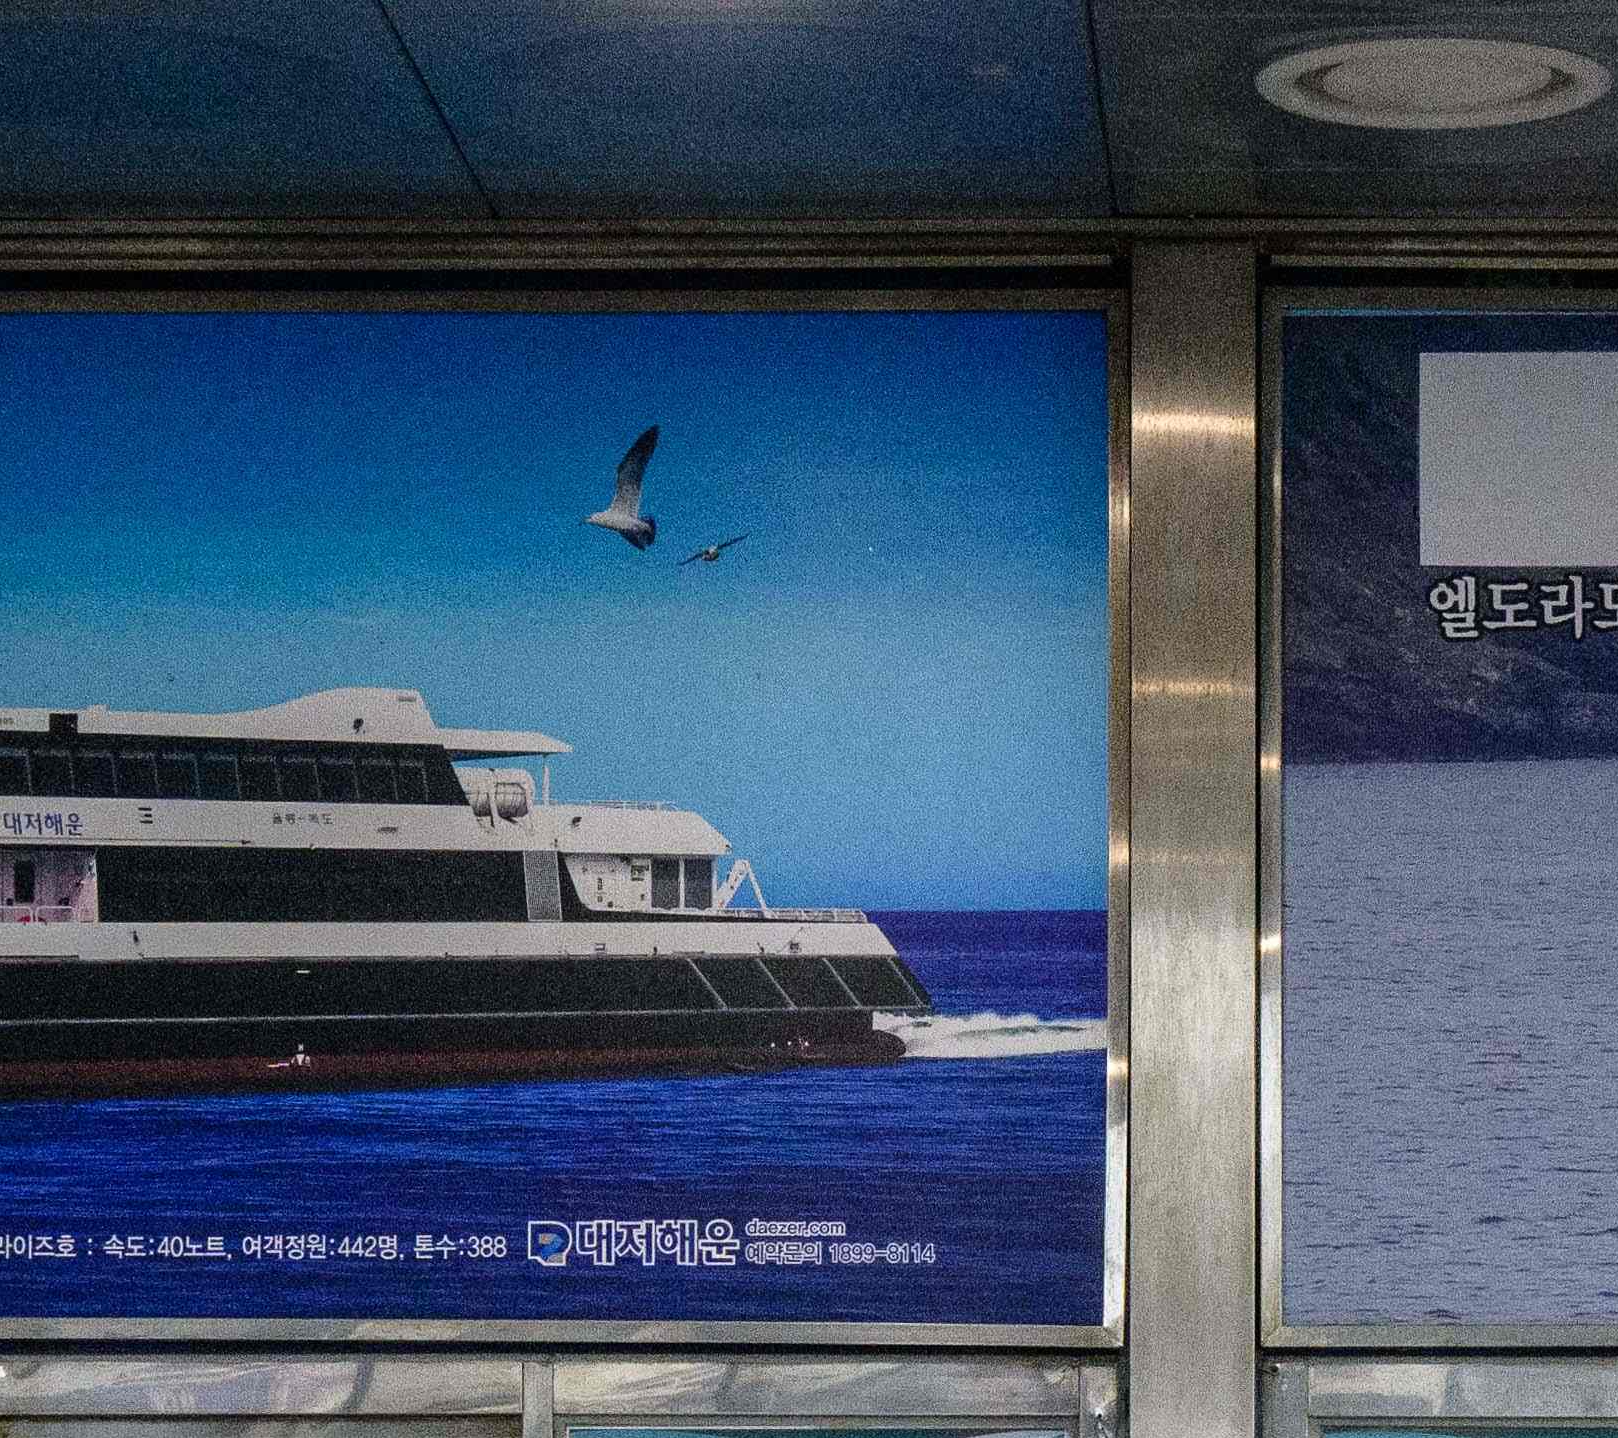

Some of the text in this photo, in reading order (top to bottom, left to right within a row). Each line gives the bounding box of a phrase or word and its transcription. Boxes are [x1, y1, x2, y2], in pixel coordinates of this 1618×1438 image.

[2, 812, 83, 837] 대저해운
[744, 1217, 847, 1238] daezer.com
[413, 1233, 508, 1260] 톤수:388
[575, 1218, 741, 1266] 대저해운
[745, 1241, 936, 1265] 예약문의 1899-8114
